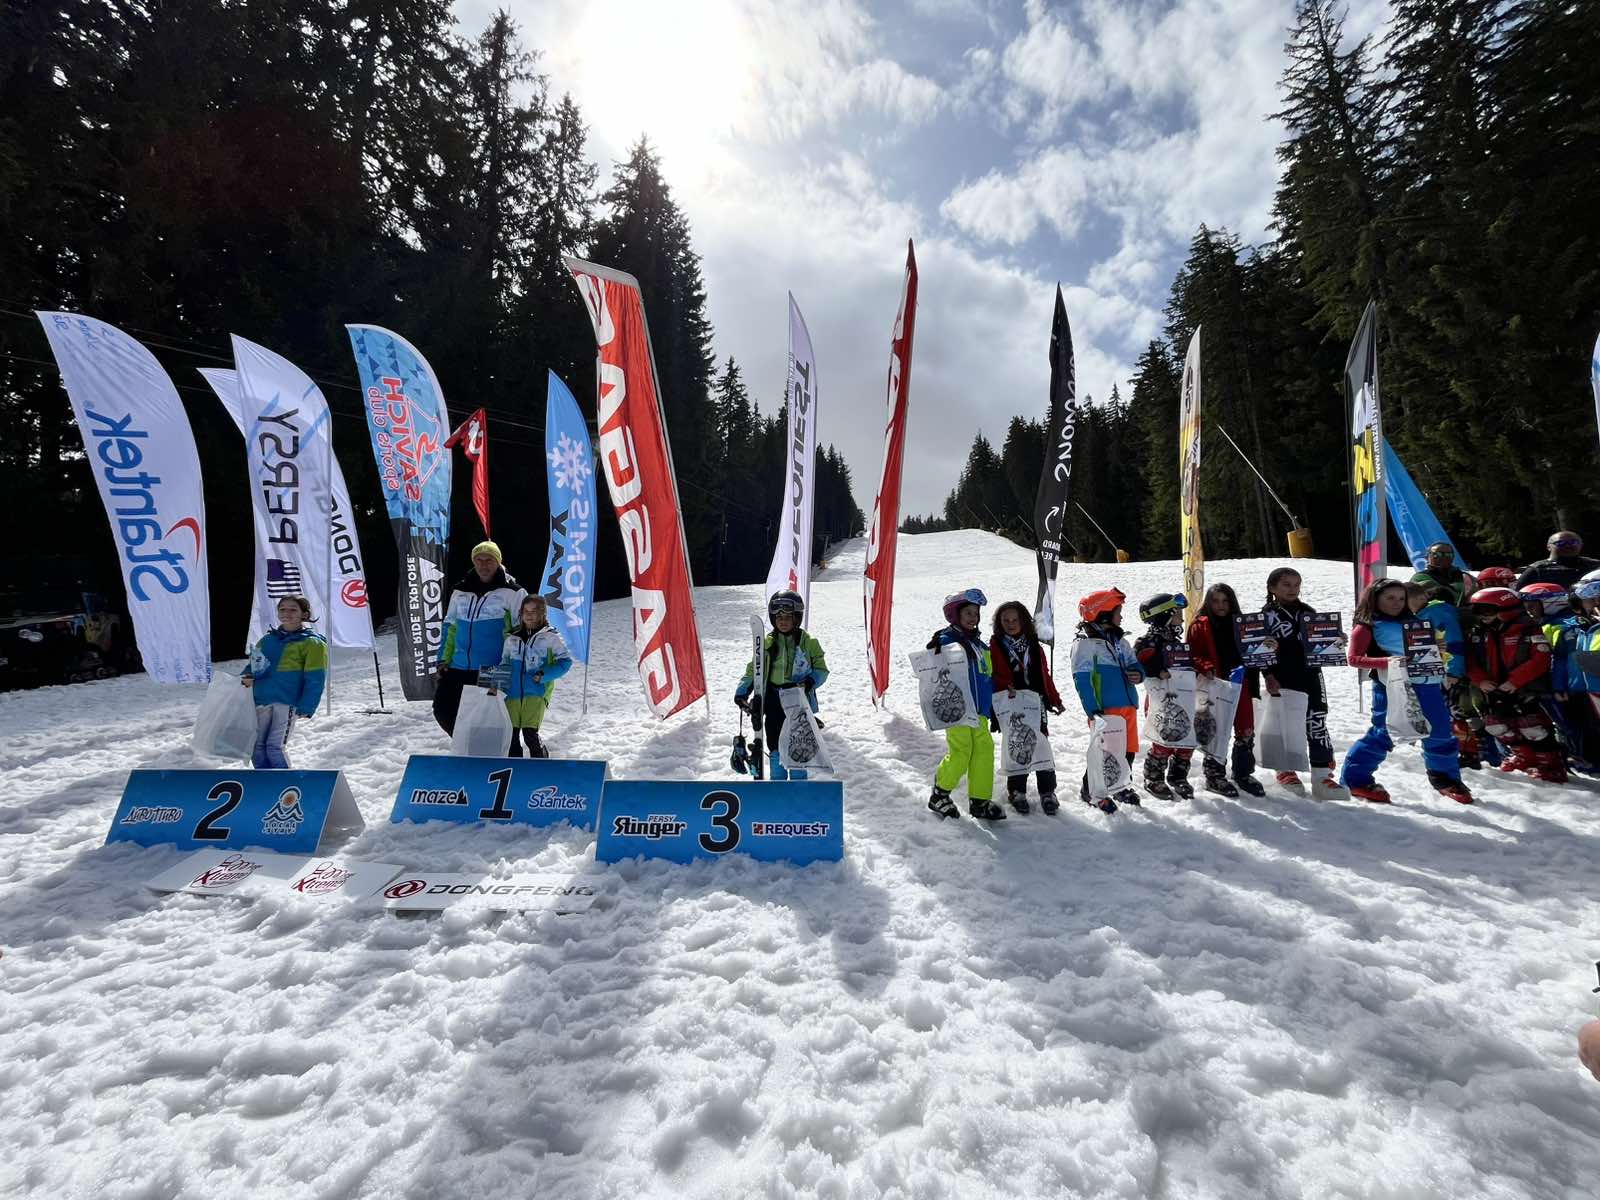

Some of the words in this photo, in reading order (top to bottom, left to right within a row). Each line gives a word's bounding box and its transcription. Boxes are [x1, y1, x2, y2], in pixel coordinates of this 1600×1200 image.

[410, 787, 457, 806] maze
[478, 767, 514, 820] 1
[528, 792, 586, 811] Stantek
[192, 780, 244, 840] 2
[648, 814, 675, 823] PERSY
[699, 789, 740, 853] 3
[765, 821, 829, 837] REQUEST
[426, 884, 595, 896] DONGFENG
